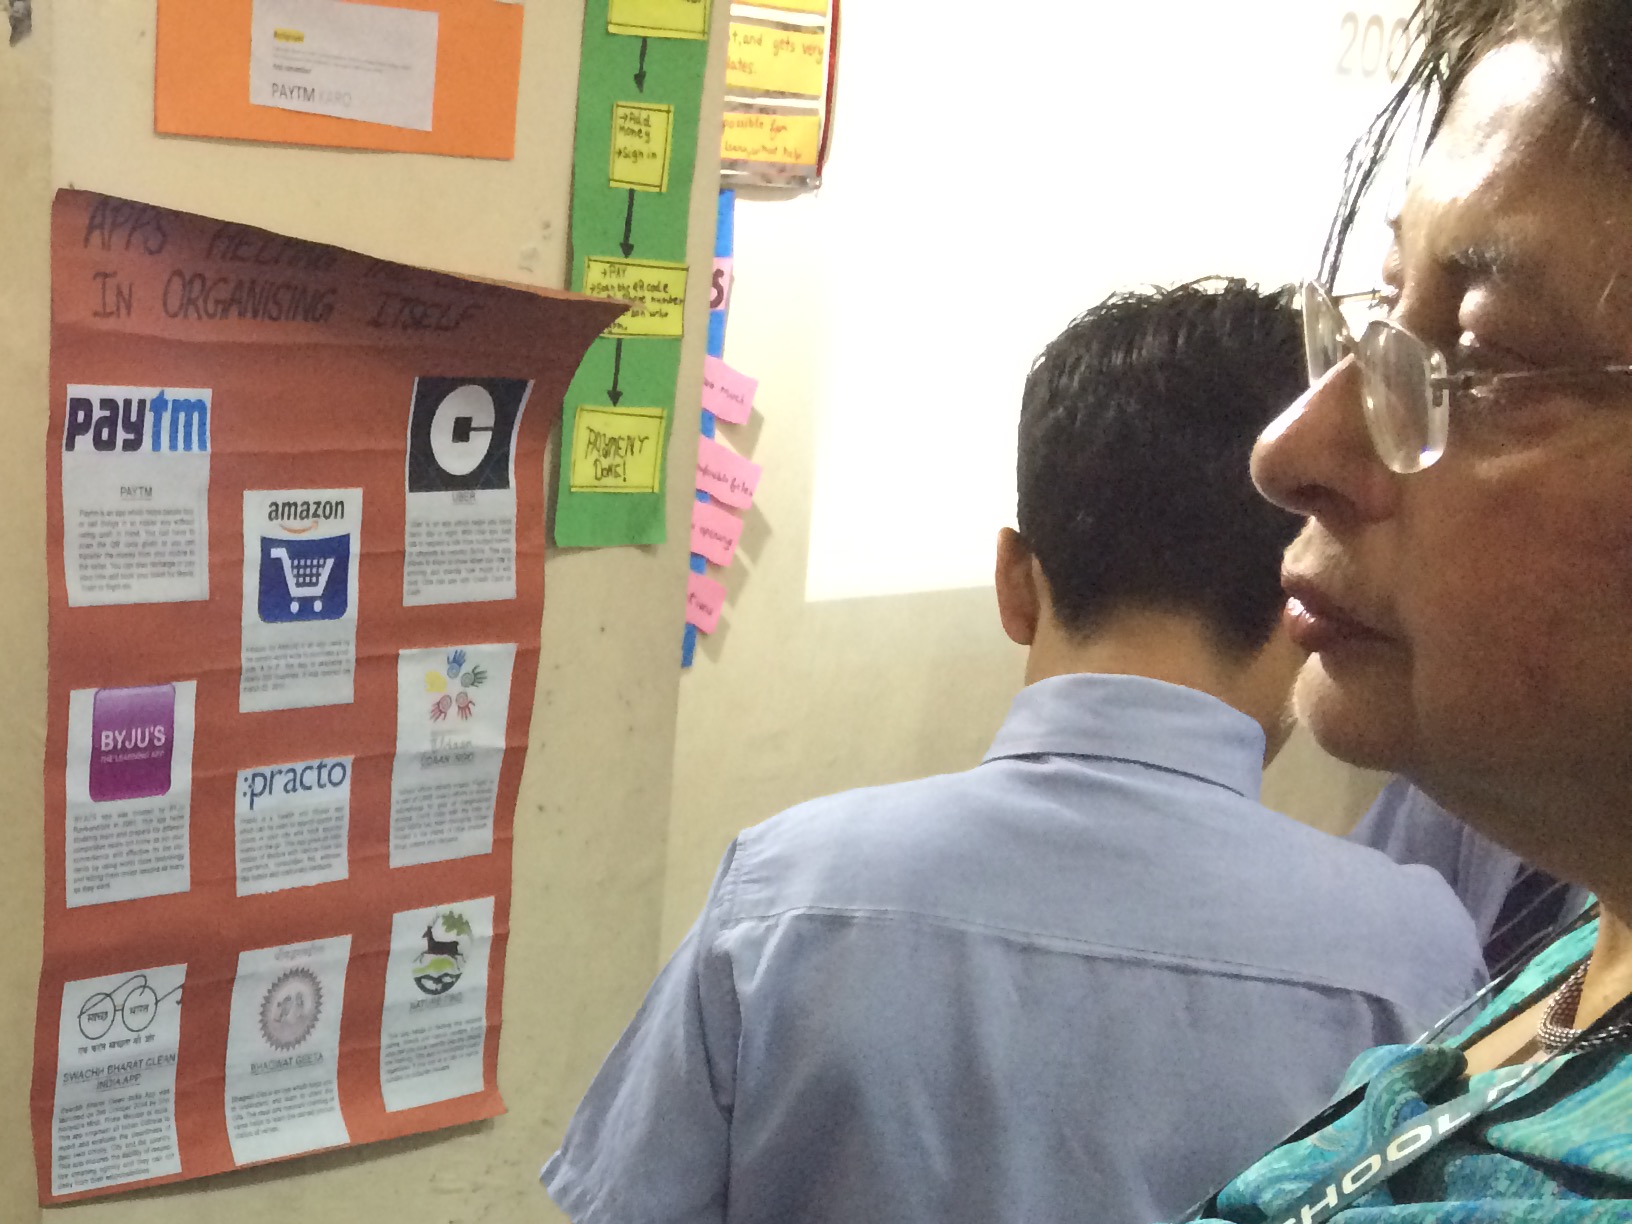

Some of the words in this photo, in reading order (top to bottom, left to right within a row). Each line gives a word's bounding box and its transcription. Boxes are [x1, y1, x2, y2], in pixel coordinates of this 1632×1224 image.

[272, 82, 315, 102] PAYTM
[163, 269, 337, 323] ORGANISING
[120, 486, 153, 497] PAYTM
[268, 500, 345, 521] amazon
[100, 725, 166, 752] BYJU'S
[63, 1066, 105, 1083] SWACHH
[107, 1059, 143, 1076] BHARAT
[145, 1053, 176, 1067] CLEAN
